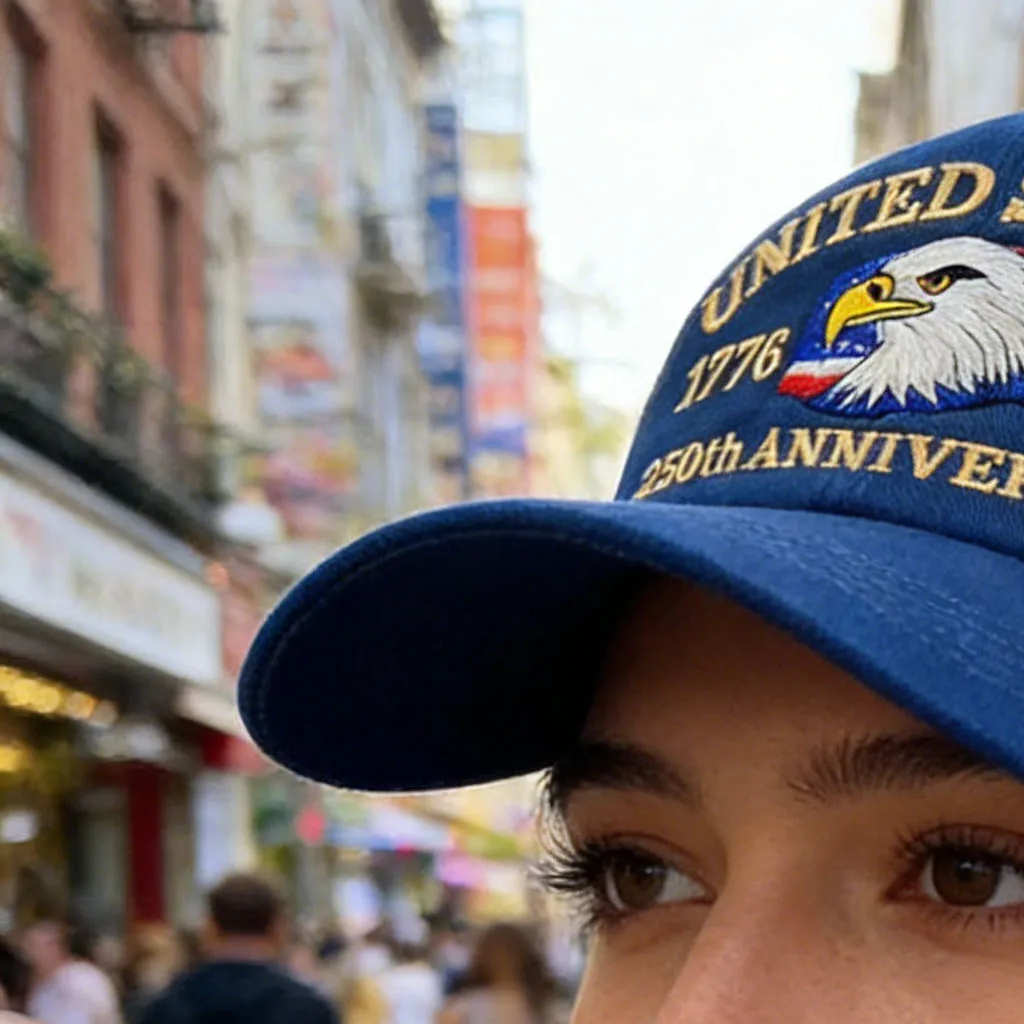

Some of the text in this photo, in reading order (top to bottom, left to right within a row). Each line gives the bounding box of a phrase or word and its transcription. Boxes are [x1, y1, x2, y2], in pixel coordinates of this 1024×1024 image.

[700, 161, 995, 333] UNITED
[673, 327, 791, 413] 1776
[632, 431, 743, 500] 250th
